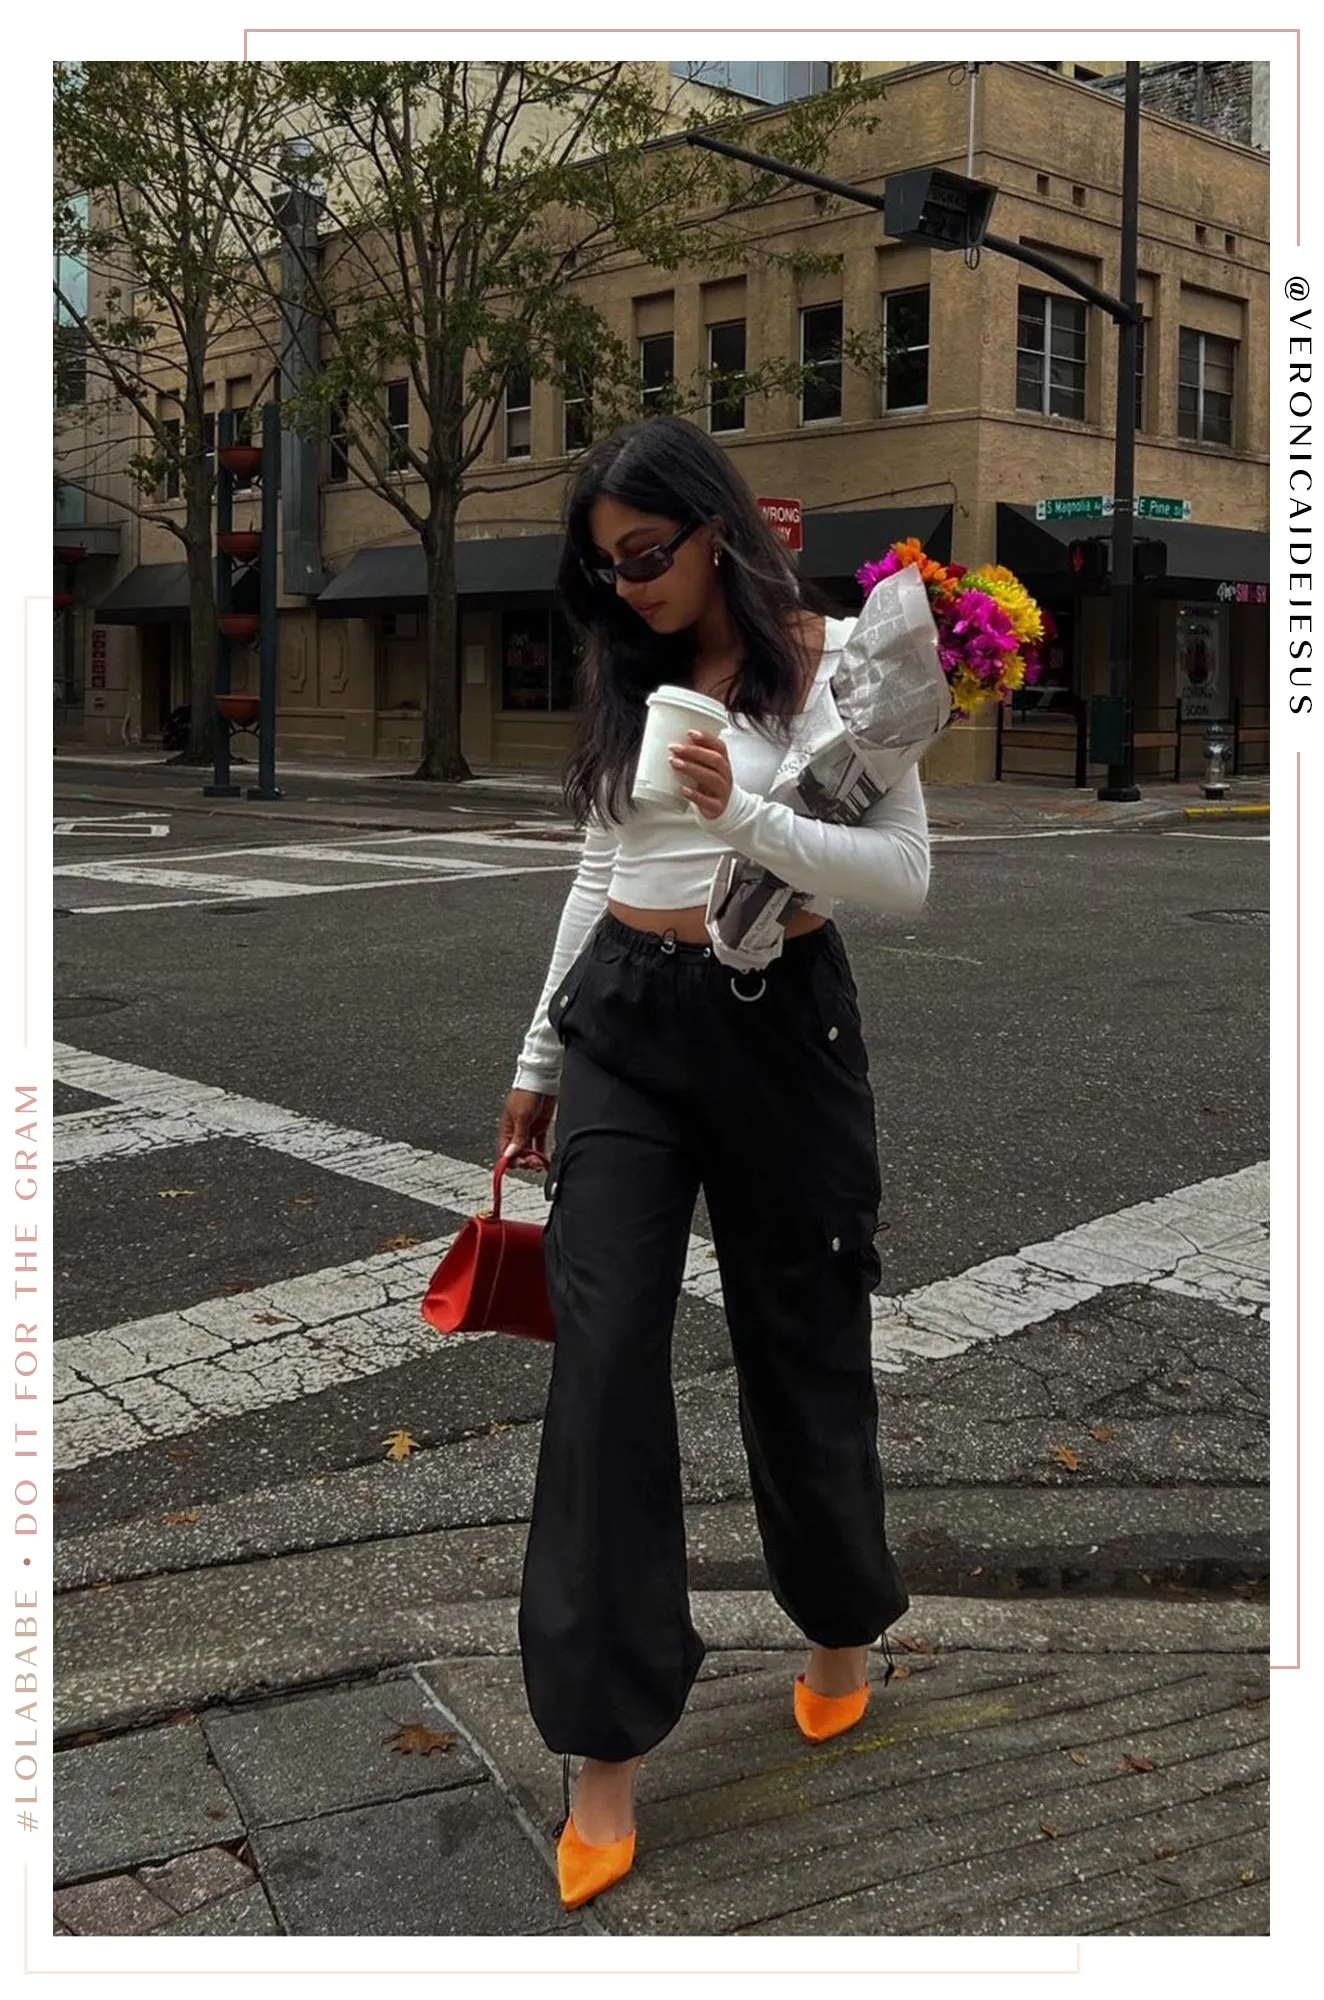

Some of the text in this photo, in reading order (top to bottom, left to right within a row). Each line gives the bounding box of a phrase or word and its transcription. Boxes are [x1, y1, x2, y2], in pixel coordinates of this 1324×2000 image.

[1055, 500, 1091, 517] Magnolia
[1139, 500, 1145, 513] E
[1150, 500, 1170, 515] Pine
